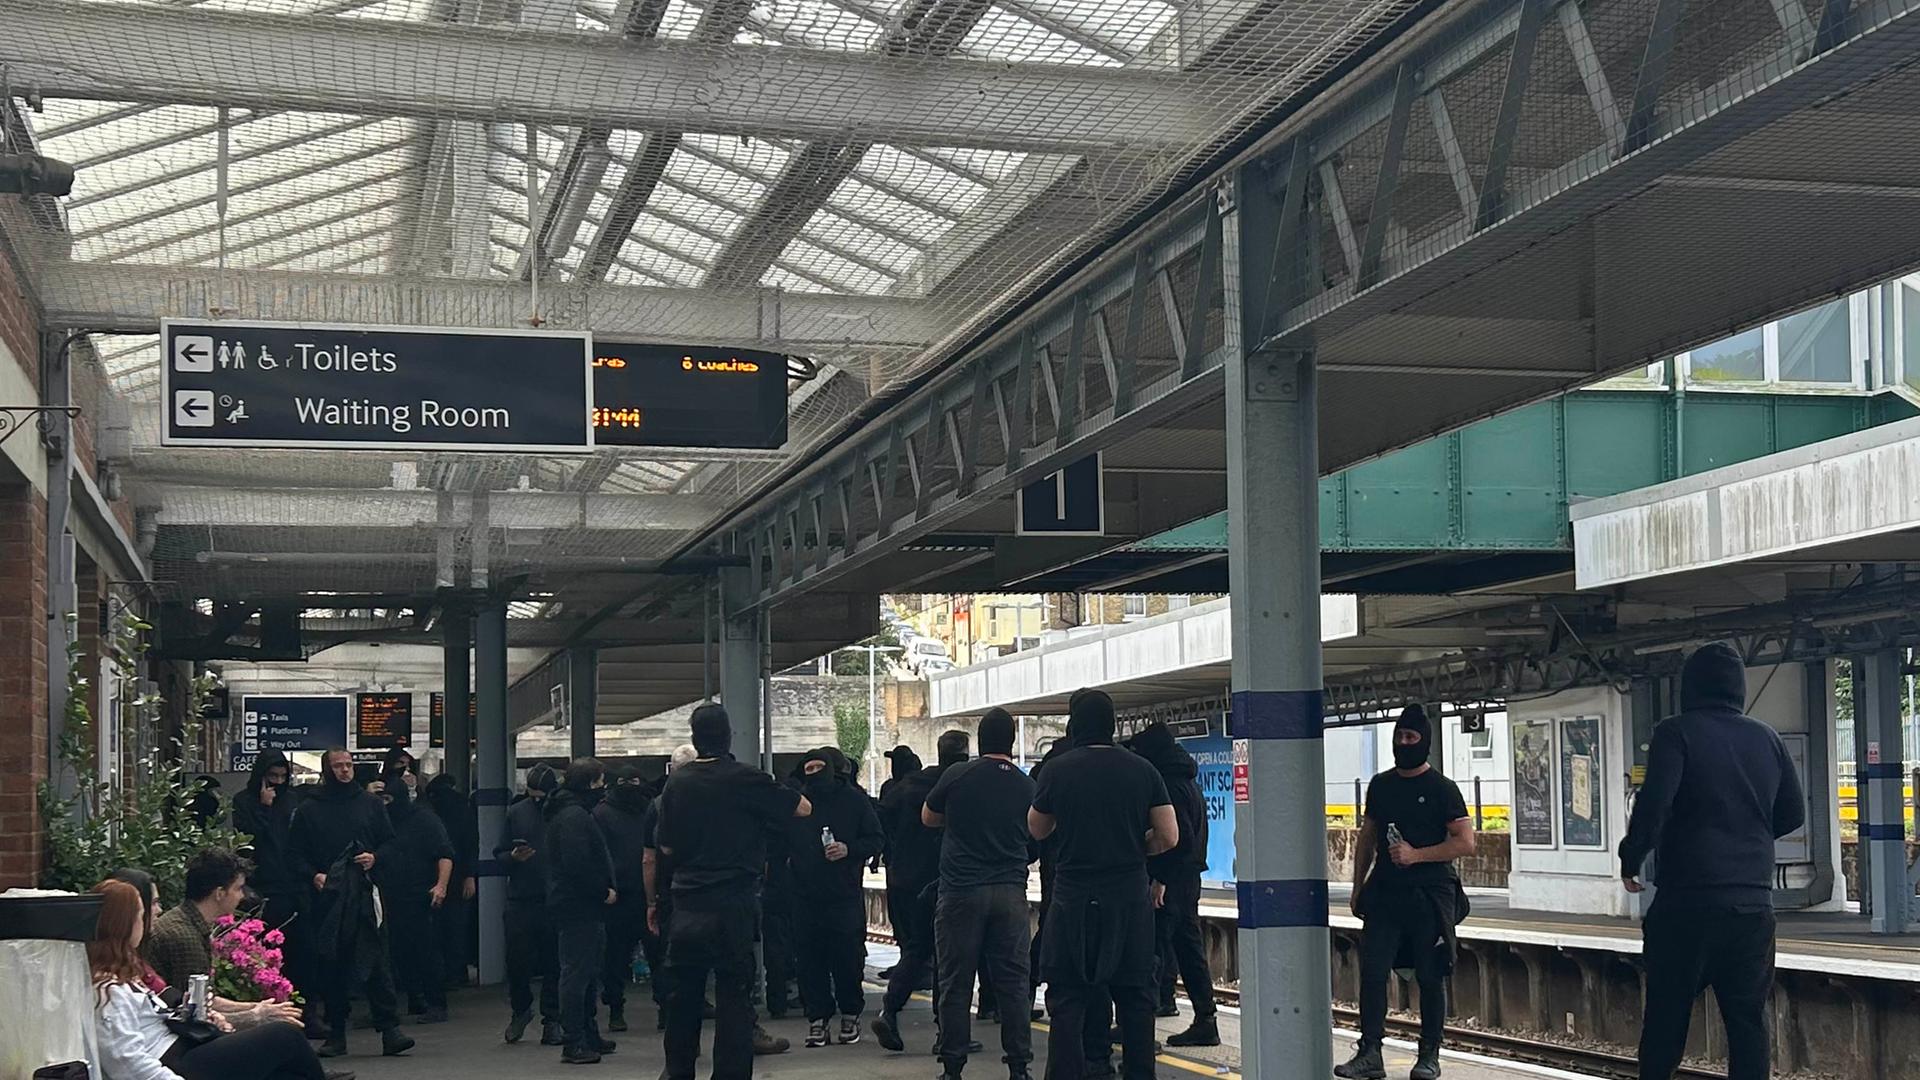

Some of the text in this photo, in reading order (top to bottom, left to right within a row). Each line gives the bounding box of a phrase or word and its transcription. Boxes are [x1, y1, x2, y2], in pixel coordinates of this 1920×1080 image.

[294, 343, 397, 372] Toilets
[294, 397, 510, 433] Waiting Room
[1043, 468, 1066, 520] 1
[271, 713, 289, 721] Taxis
[1469, 714, 1480, 730] 3
[271, 727, 309, 735] Platform 2
[270, 740, 301, 750] Way Out
